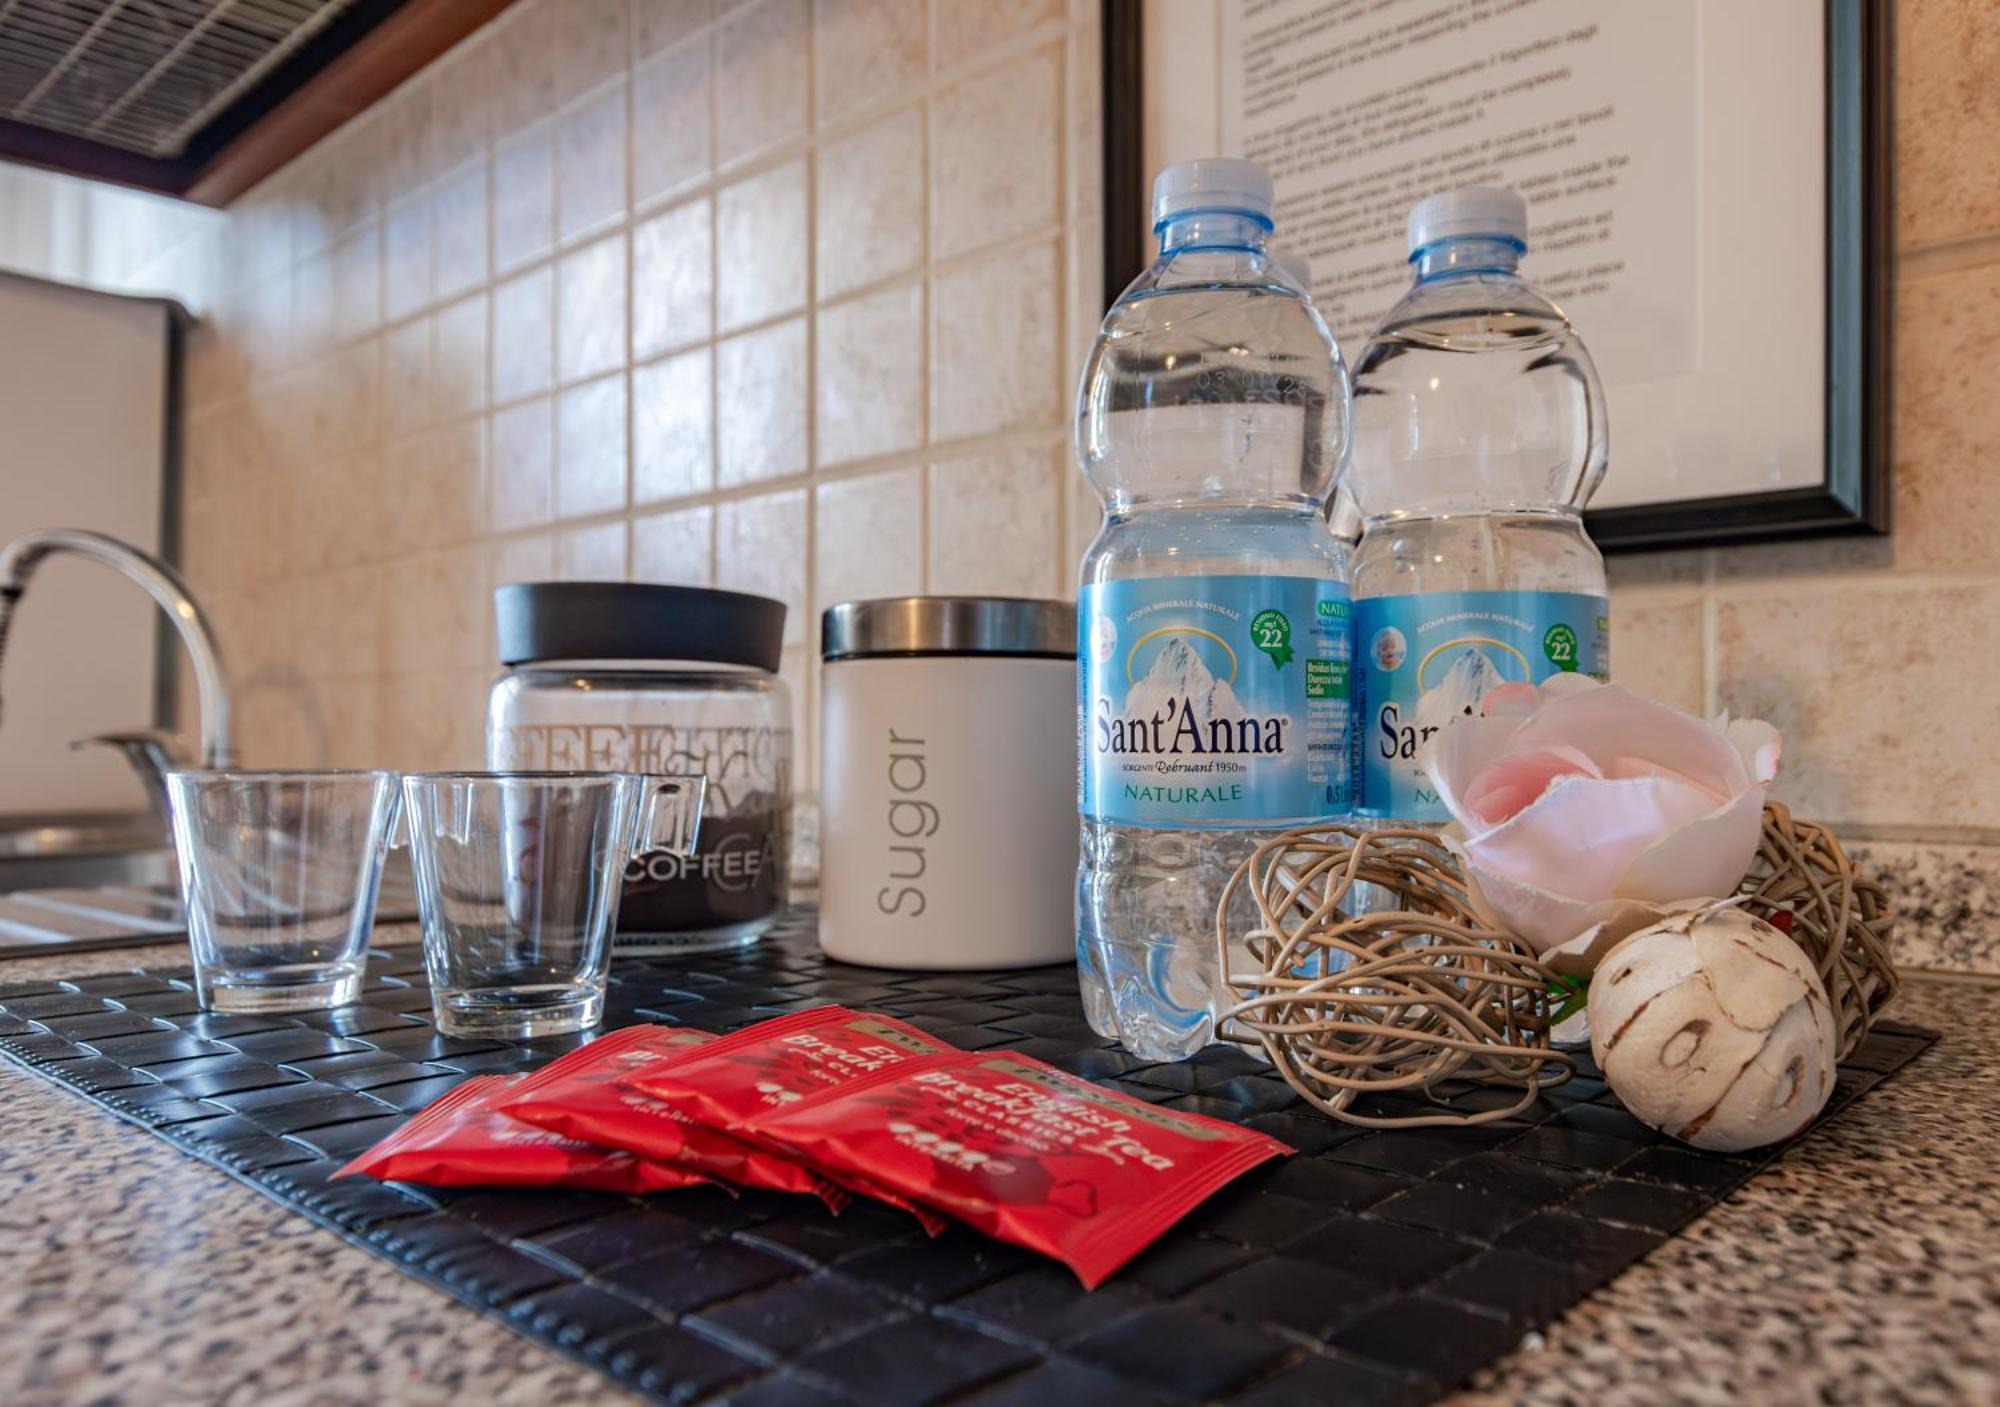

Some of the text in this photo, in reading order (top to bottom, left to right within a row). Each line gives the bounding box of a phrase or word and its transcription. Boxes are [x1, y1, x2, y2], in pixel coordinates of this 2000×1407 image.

[1260, 628, 1282, 648] 22
[1551, 641, 1571, 661] 22
[1098, 695, 1285, 754] Sant'Anna
[1124, 783, 1244, 804] NATURALE
[878, 728, 940, 917] Sugar
[622, 850, 761, 882] COFFEE
[911, 1070, 1100, 1137] Breakfast
[1103, 1134, 1174, 1172] Tea
[993, 1081, 1132, 1134] English
